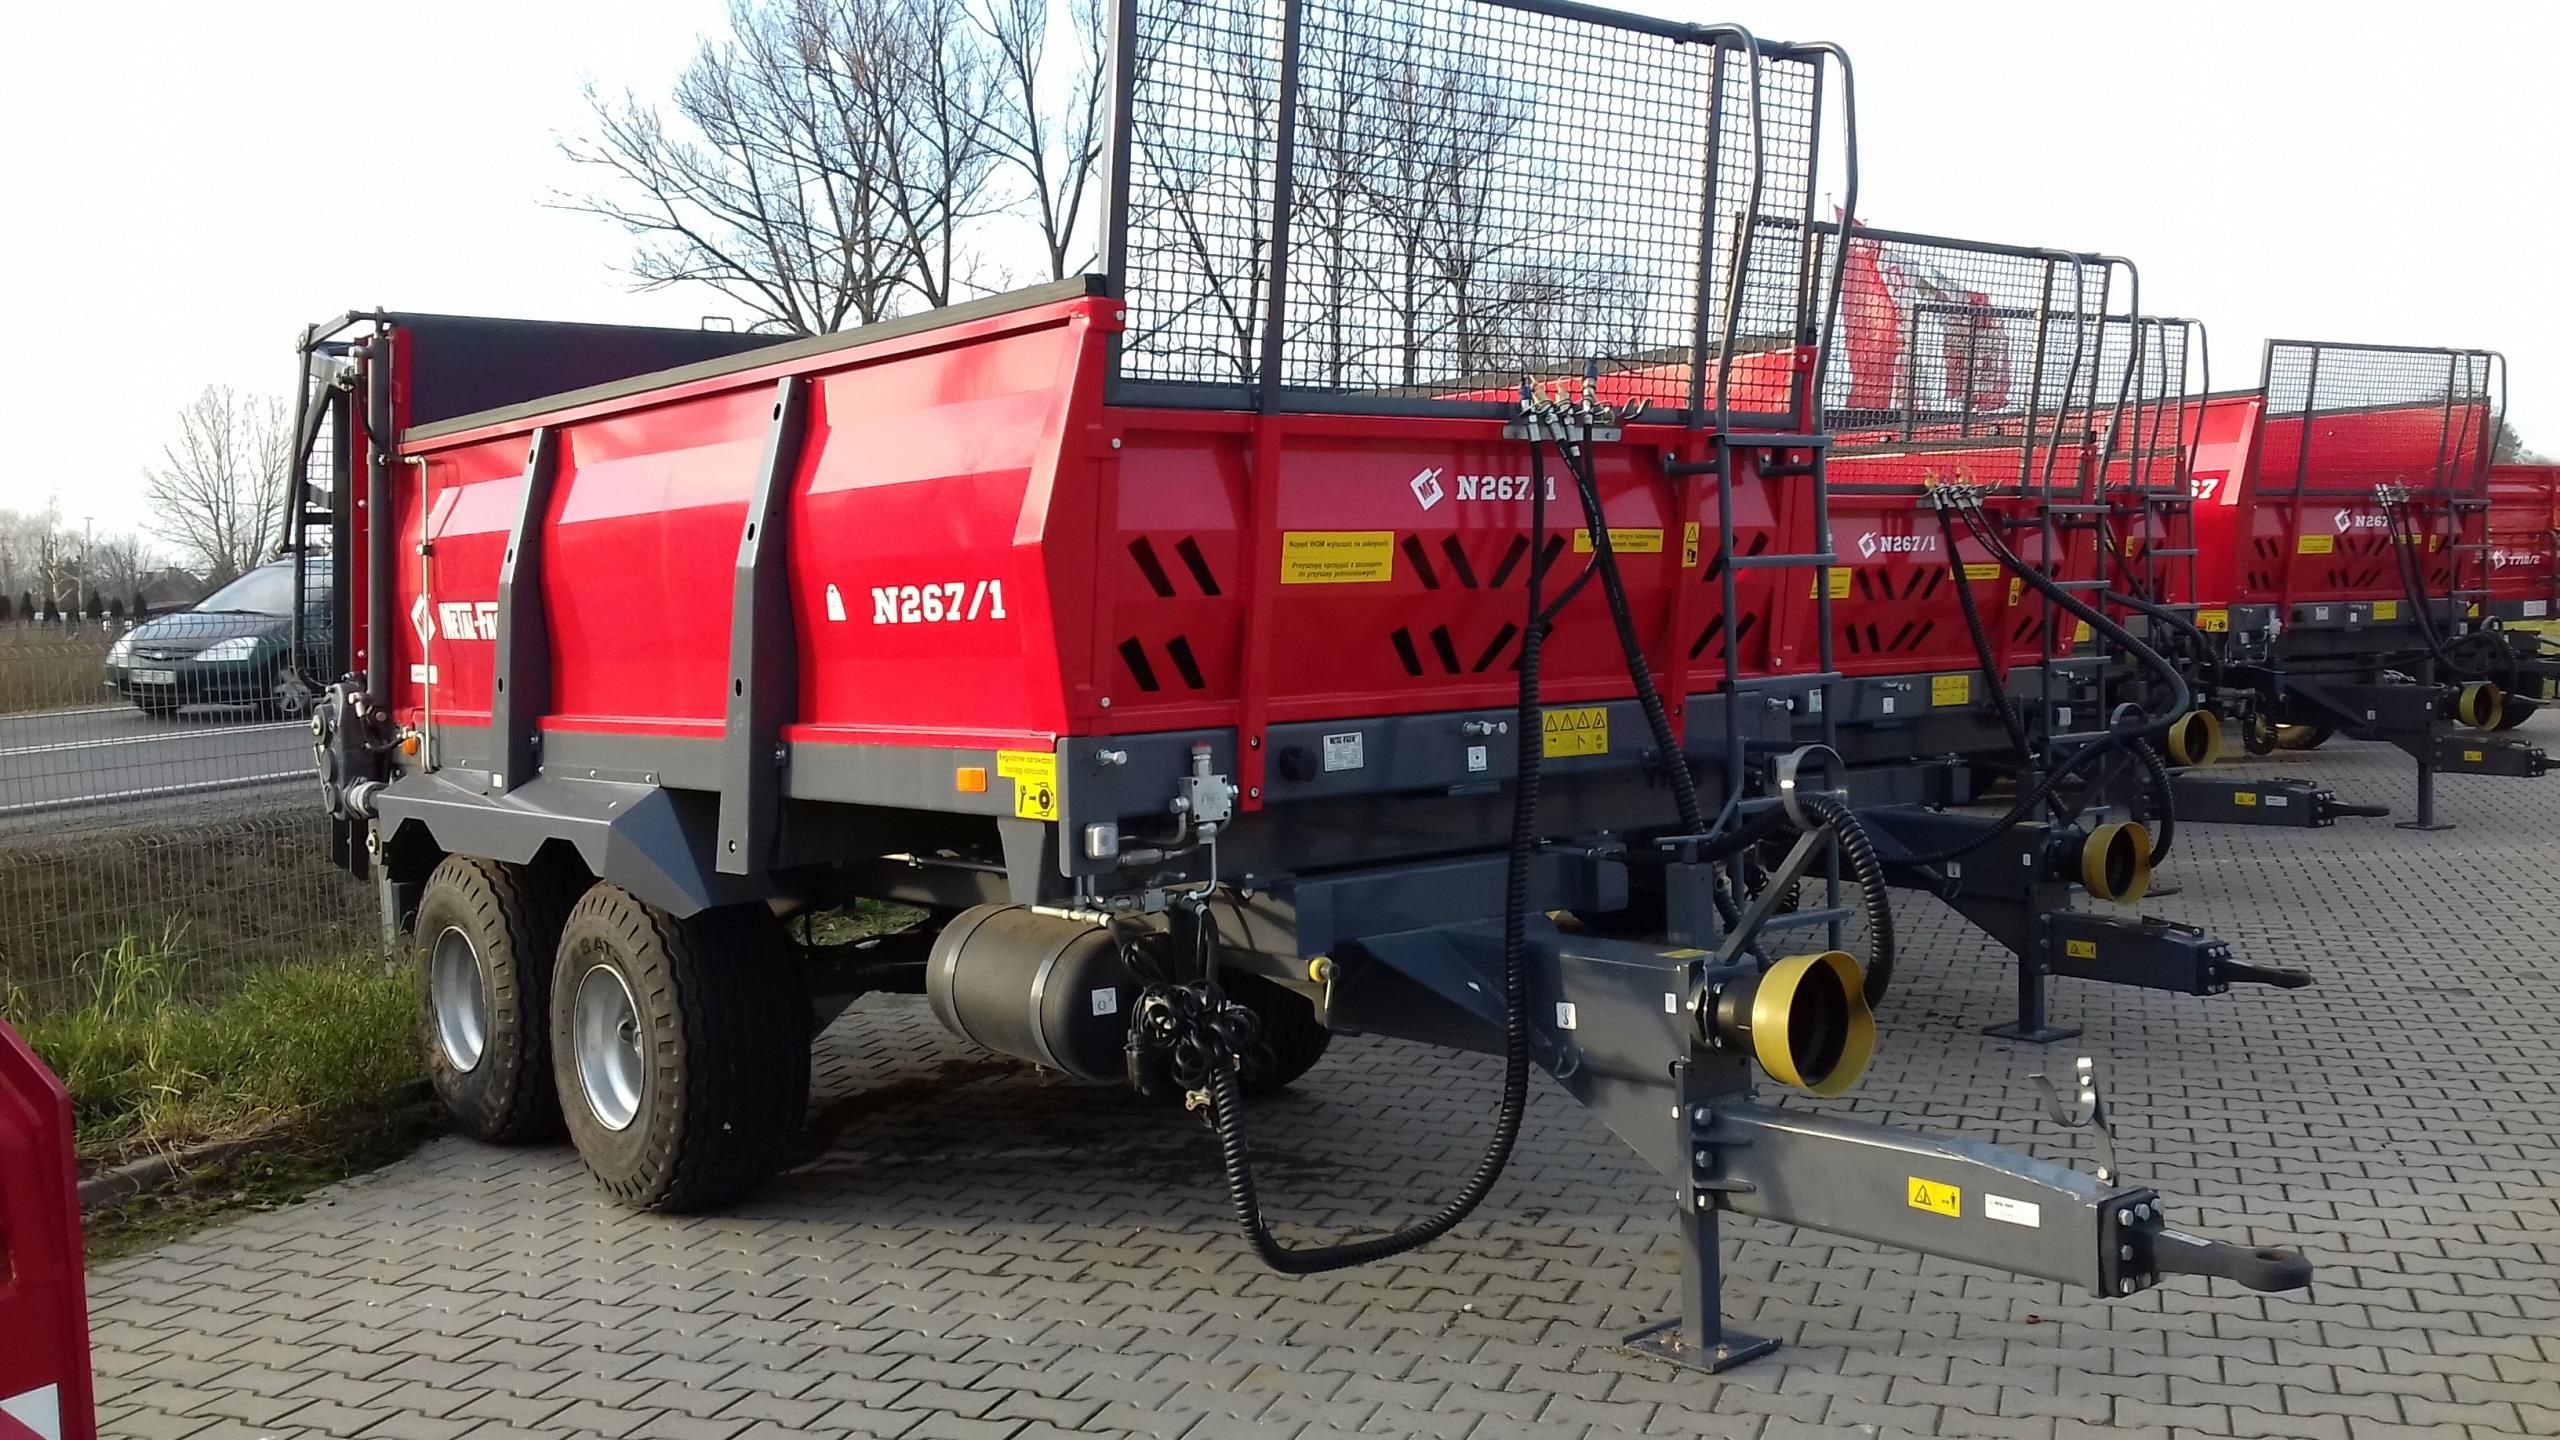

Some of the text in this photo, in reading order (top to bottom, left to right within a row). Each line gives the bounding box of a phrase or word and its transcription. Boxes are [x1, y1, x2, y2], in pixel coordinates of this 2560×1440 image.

[1456, 475, 1557, 501] N2671
[1880, 535, 1936, 553] N267/1
[871, 578, 1007, 625] N267/1
